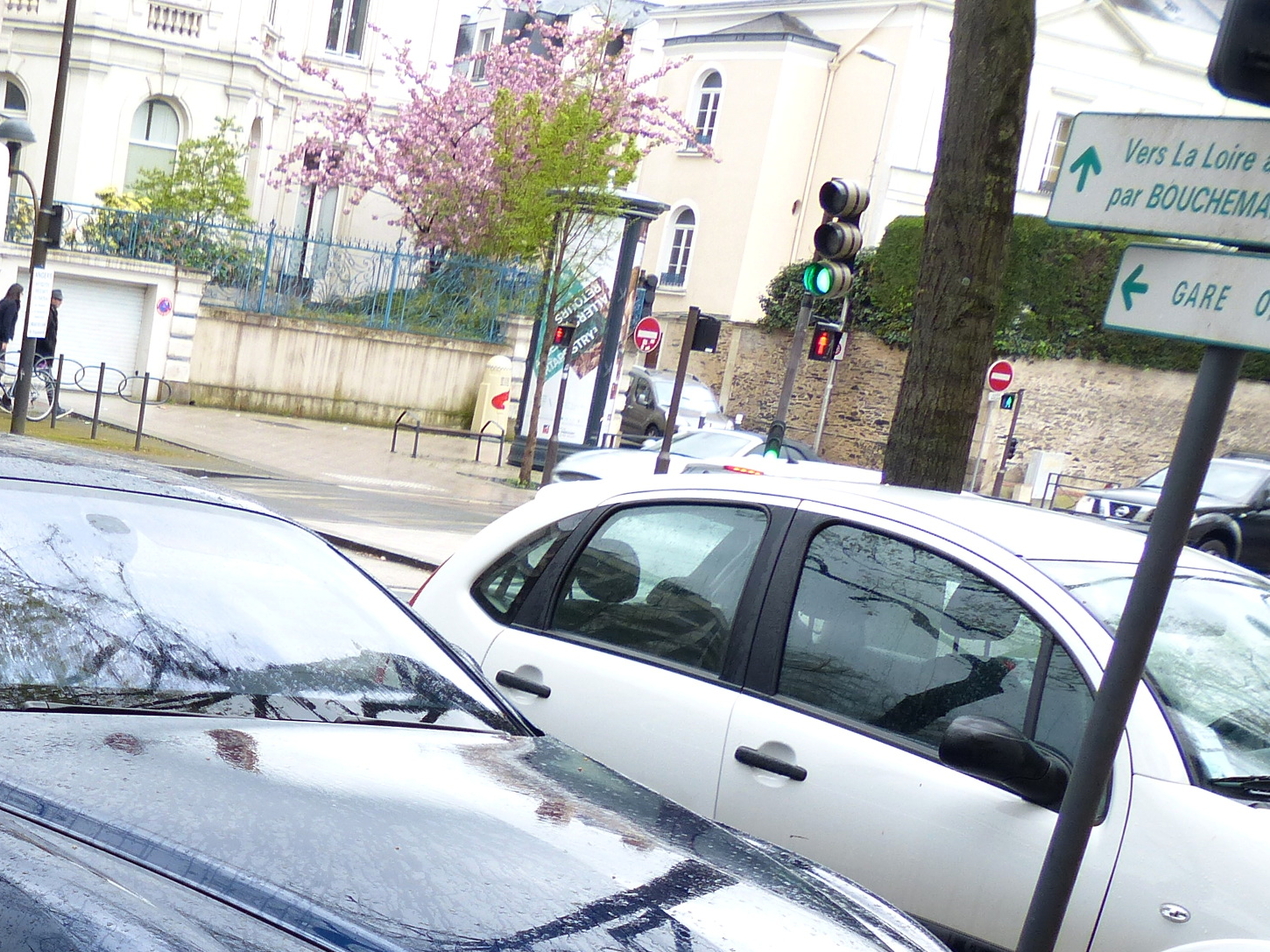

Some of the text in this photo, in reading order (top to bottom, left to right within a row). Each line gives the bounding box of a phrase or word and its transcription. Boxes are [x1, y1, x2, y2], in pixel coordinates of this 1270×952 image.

[1125, 138, 1168, 166] Vers
[1172, 141, 1195, 167] La
[1202, 142, 1257, 172] Loire
[1105, 183, 1270, 219] par BOUCHEMA
[1171, 281, 1232, 311] GARE
